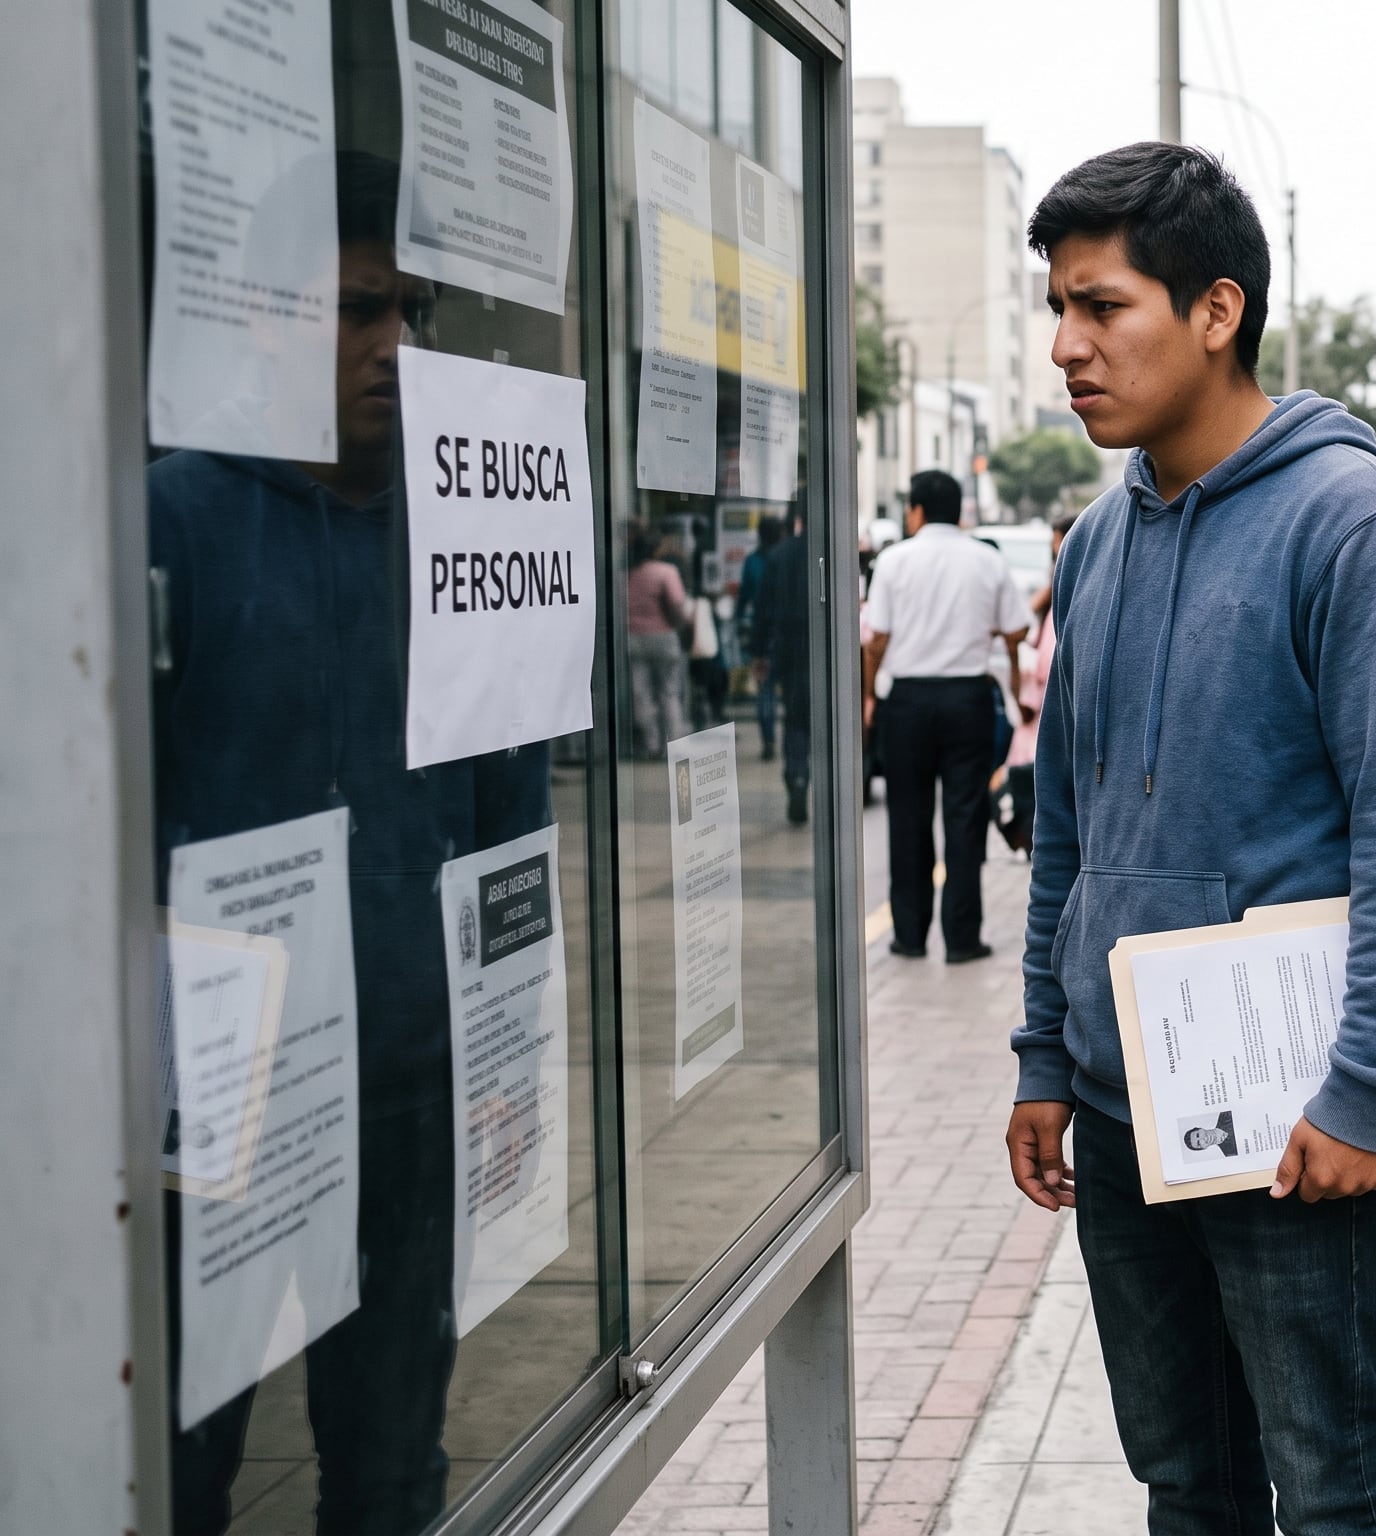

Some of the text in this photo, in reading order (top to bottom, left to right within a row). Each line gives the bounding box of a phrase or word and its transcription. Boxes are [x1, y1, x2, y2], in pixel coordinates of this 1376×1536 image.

[436, 435, 570, 501] SE BUSCA
[432, 551, 578, 614] PERSONAL
